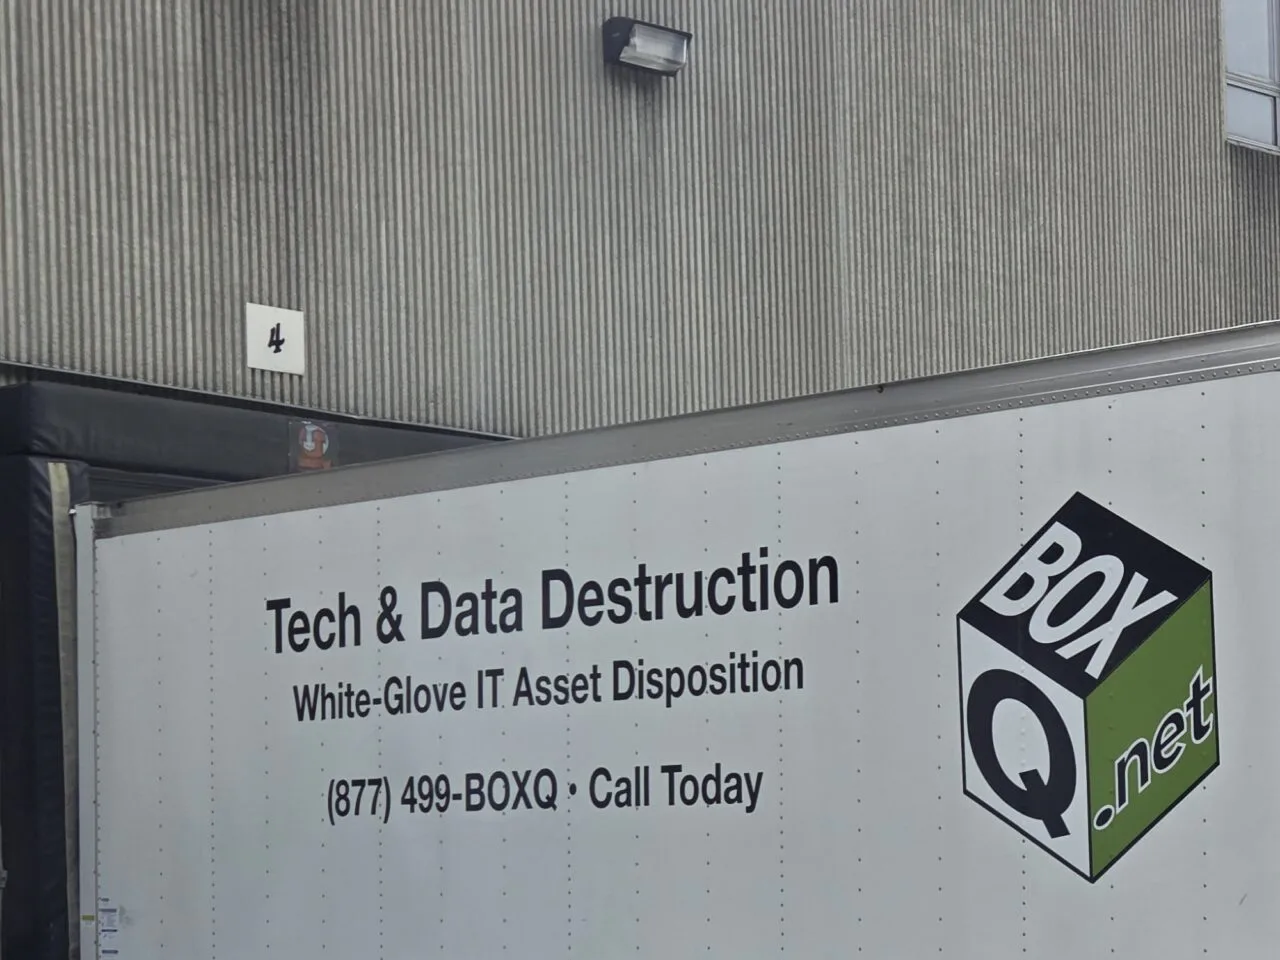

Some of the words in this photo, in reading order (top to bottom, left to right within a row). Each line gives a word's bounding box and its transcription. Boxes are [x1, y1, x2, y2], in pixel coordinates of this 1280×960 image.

[267, 322, 286, 354] 4
[266, 591, 361, 654] Tech
[376, 585, 404, 644] &
[420, 578, 523, 640] Data
[541, 546, 839, 630] Destruction
[979, 521, 1179, 680] BOX
[293, 675, 466, 722] White-Glove
[476, 668, 503, 709] IT
[512, 663, 602, 706] Asset
[611, 650, 804, 708] Disposition
[327, 776, 391, 825] (877)
[400, 768, 558, 813] 499-BOXQ
[589, 766, 650, 809] Call
[660, 763, 764, 813] Today
[966, 668, 1077, 839] Q
[1093, 664, 1215, 830] .net
